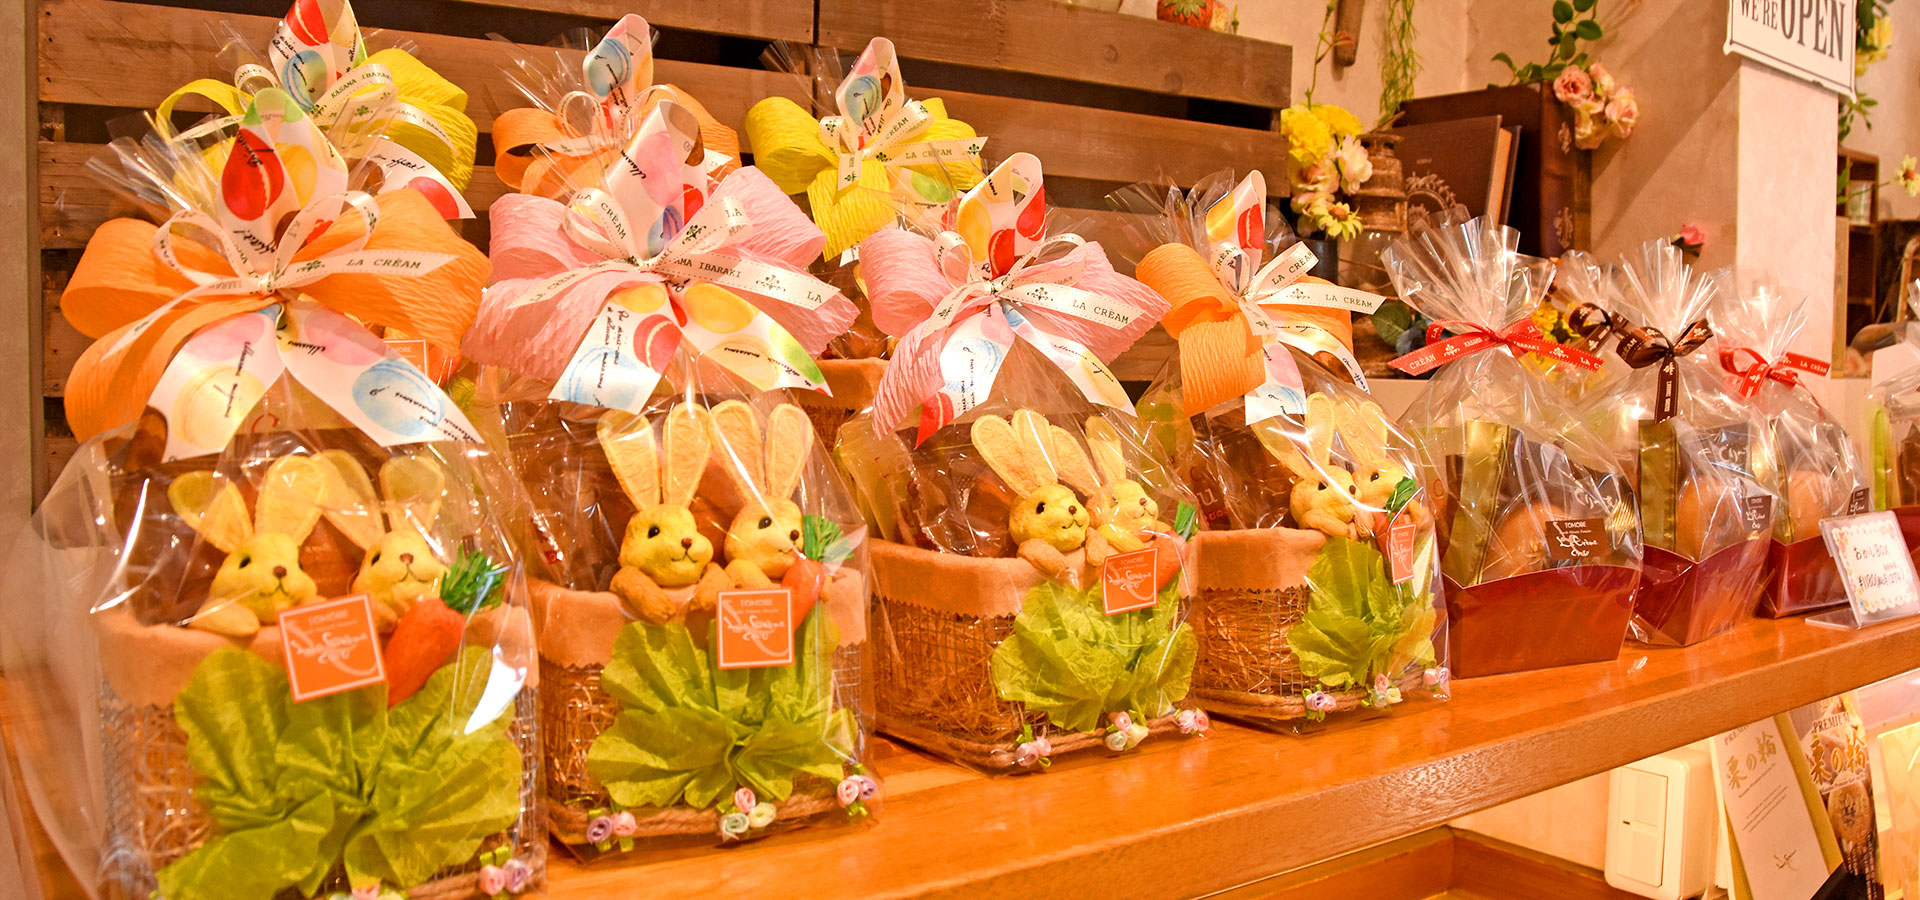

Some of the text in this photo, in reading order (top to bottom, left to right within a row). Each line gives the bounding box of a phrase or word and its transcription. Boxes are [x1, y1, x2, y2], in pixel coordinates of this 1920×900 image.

[1781, 0, 1845, 62] OPEN
[725, 207, 743, 219] LA
[346, 259, 364, 267] LA
[699, 262, 743, 279] IBARAKI
[807, 290, 823, 304] LA
[1271, 273, 1286, 286] LA
[1325, 294, 1339, 303] LA
[1072, 299, 1087, 311] LA
